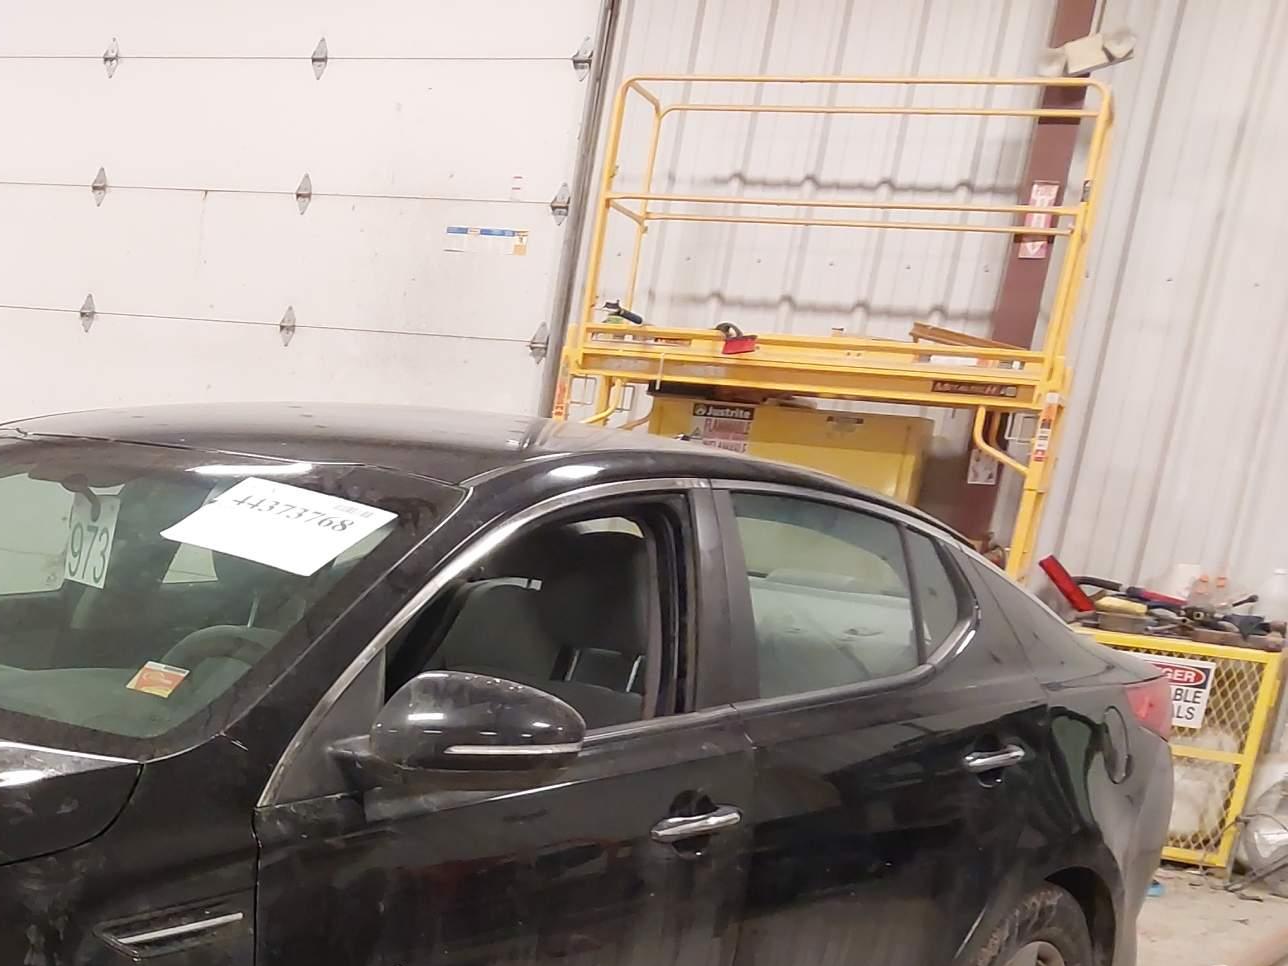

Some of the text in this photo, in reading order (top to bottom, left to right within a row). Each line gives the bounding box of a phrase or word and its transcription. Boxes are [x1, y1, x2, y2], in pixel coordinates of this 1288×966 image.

[706, 405, 752, 419] Justrite
[231, 495, 355, 532] 44373768
[68, 521, 110, 583] 973
[1173, 687, 1203, 704] BLE
